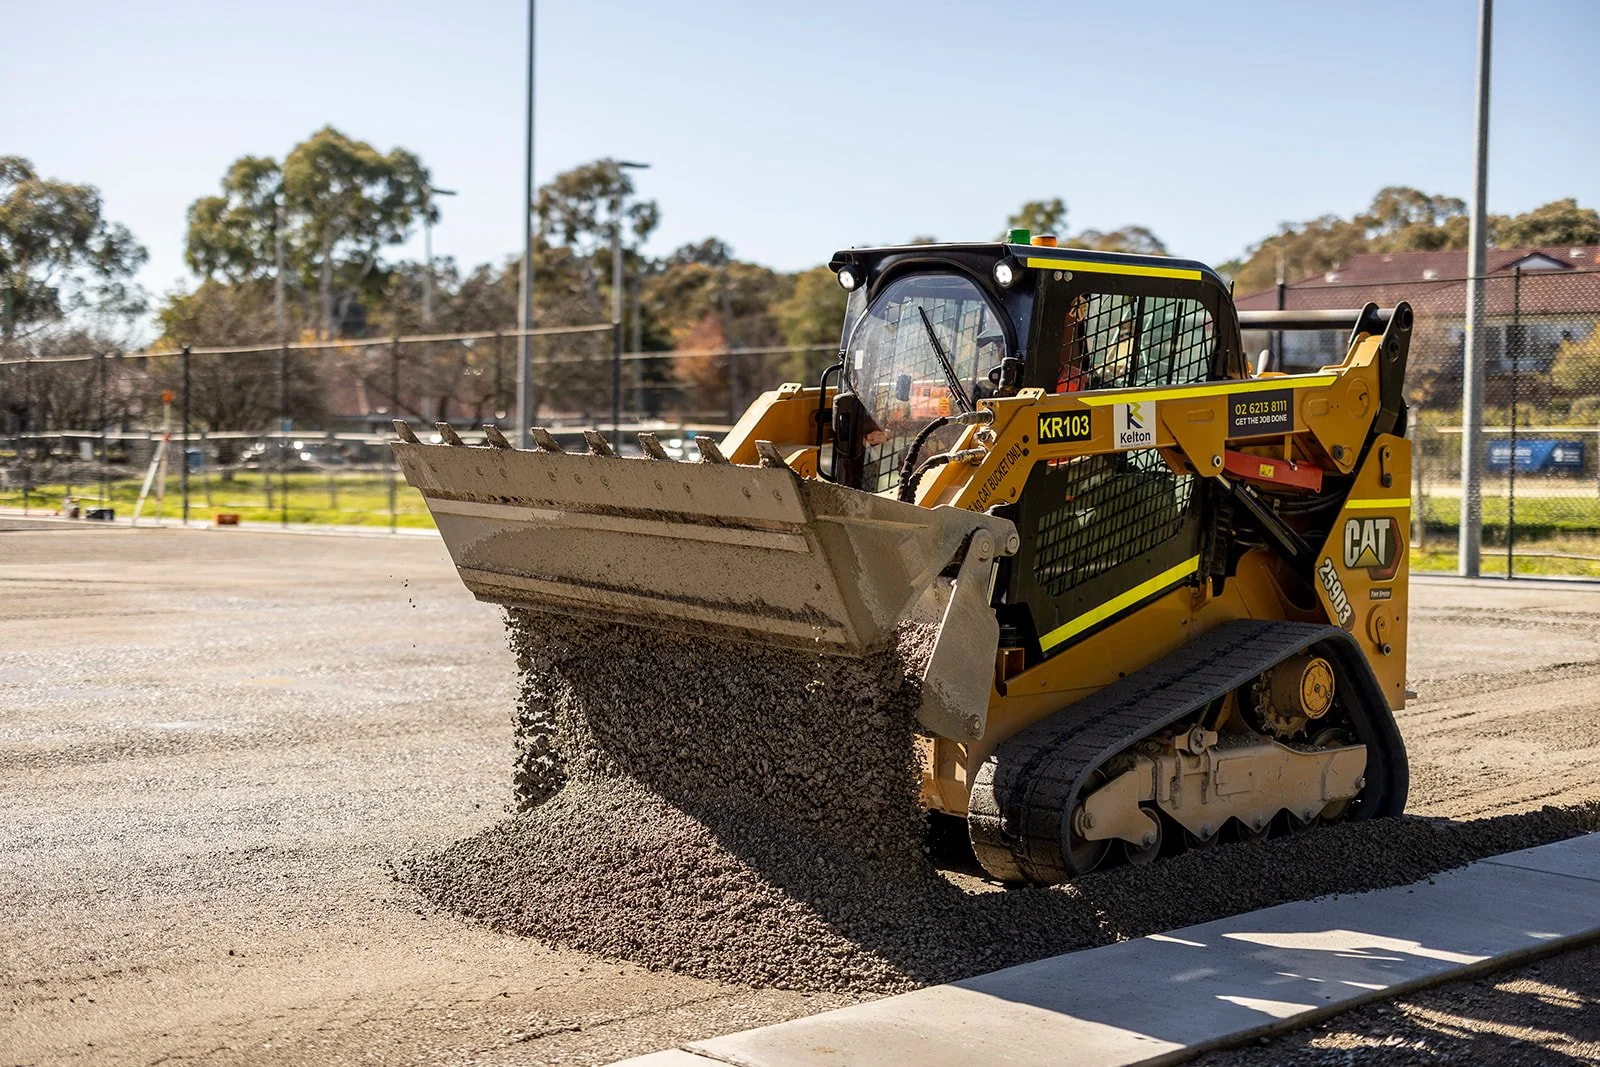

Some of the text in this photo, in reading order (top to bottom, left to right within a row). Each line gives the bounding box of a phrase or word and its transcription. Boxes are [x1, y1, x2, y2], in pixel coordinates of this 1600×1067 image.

[1235, 400, 1287, 415] 02 6213 8111
[1040, 415, 1089, 439] KR103
[1235, 414, 1288, 426] GET THE JOB DONE
[1120, 431, 1151, 444] Kelton
[978, 483, 992, 503] CAT
[987, 458, 1010, 490] BUCKET
[1006, 442, 1023, 465] ONLY
[1345, 518, 1390, 568] CAT
[1318, 557, 1352, 625] 259D3
